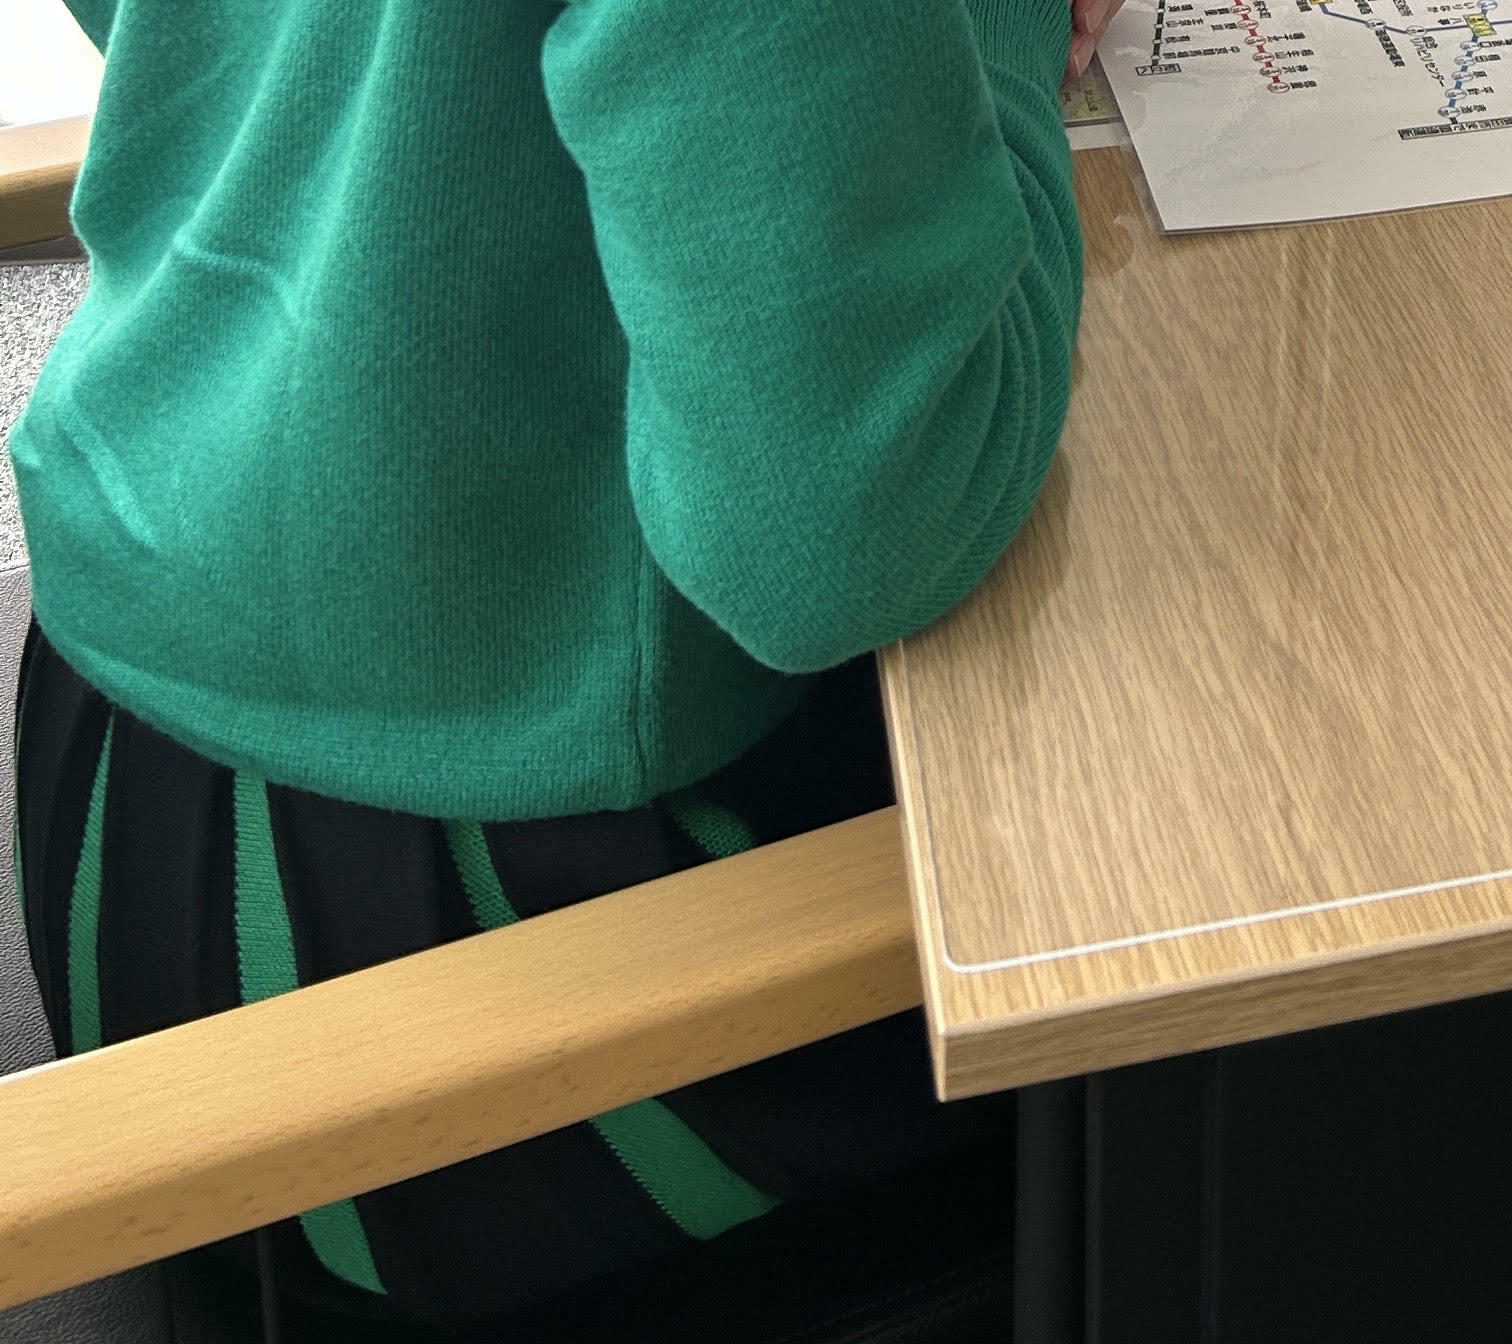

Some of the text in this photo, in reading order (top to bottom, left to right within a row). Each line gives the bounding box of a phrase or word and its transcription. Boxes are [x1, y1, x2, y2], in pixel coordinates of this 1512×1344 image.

[1409, 37, 1449, 88] リハビリセンター
